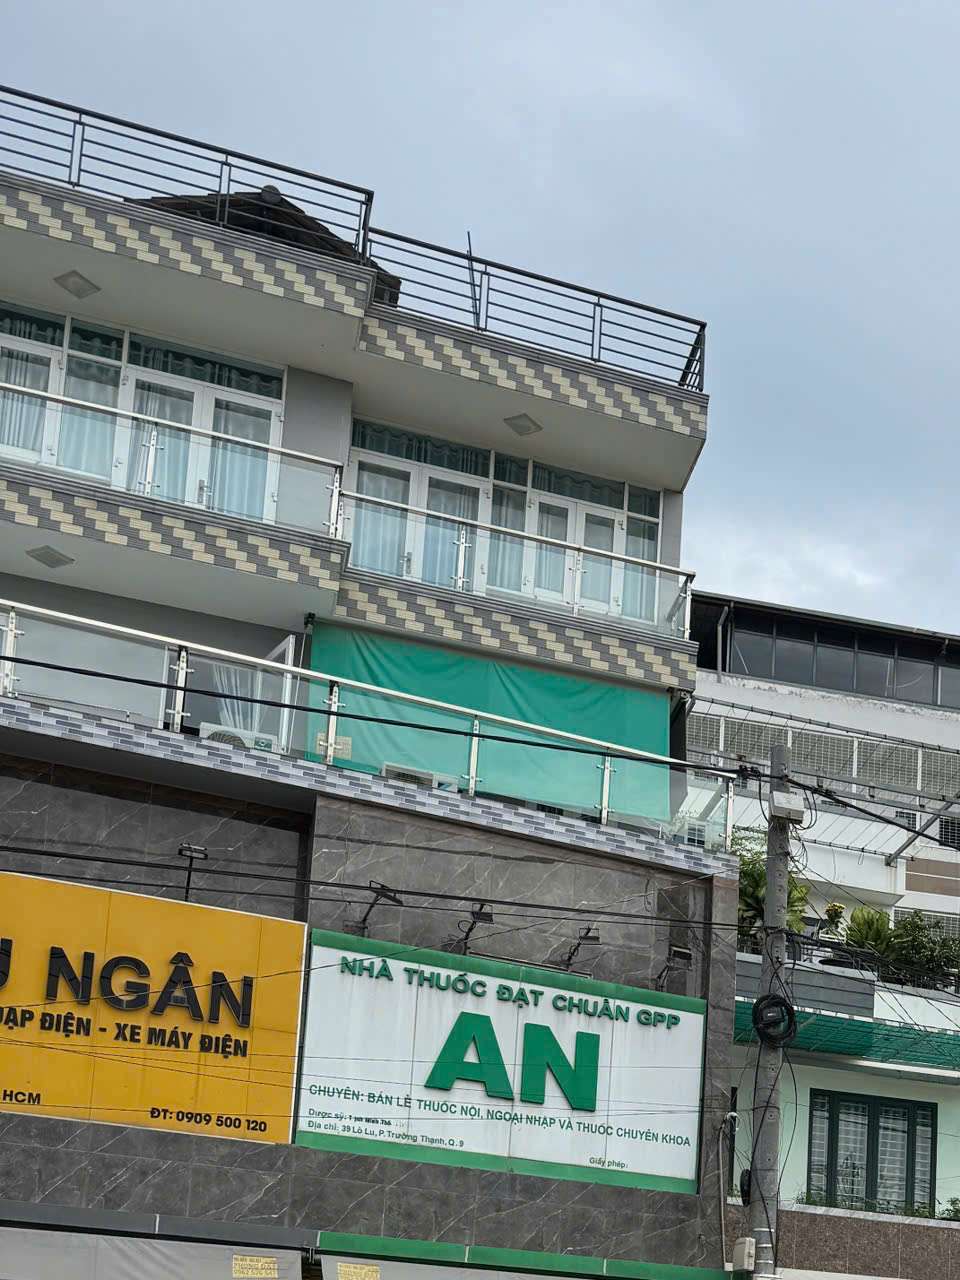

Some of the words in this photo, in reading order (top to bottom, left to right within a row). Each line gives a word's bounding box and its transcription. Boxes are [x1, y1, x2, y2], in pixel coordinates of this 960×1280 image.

[46, 945, 254, 1028] NGÂN
[340, 955, 393, 981] NHÀ
[403, 966, 487, 997] THUỐC
[496, 984, 544, 1008] ĐẠT
[552, 994, 630, 1022] CHUẨN
[636, 1008, 681, 1029] GPP
[40, 1012, 91, 1037] ĐIỆN
[114, 1022, 141, 1043] XE
[147, 1026, 193, 1050] MÁY
[200, 1034, 248, 1058] ĐIỆN
[424, 1011, 601, 1112] AN
[2, 1089, 41, 1105] HCM
[150, 1107, 173, 1120] ĐT:
[176, 1111, 212, 1125] 0909
[215, 1116, 241, 1129] 500
[246, 1120, 267, 1132] 120
[309, 1084, 364, 1102] CHUYÊN:
[368, 1091, 393, 1106] BÁN
[397, 1094, 412, 1108] LẺ
[417, 1099, 457, 1114] THUỐC
[487, 1109, 523, 1125] NGOẠI
[526, 1114, 556, 1129] NHẬP
[558, 1117, 574, 1131] VÀ
[576, 1121, 613, 1136] THUỐC
[616, 1127, 659, 1142] CHUYÊN
[661, 1133, 691, 1147] KHOA
[307, 1120, 322, 1130] Địa
[342, 1124, 351, 1133] 39
[352, 1126, 363, 1134] Lò
